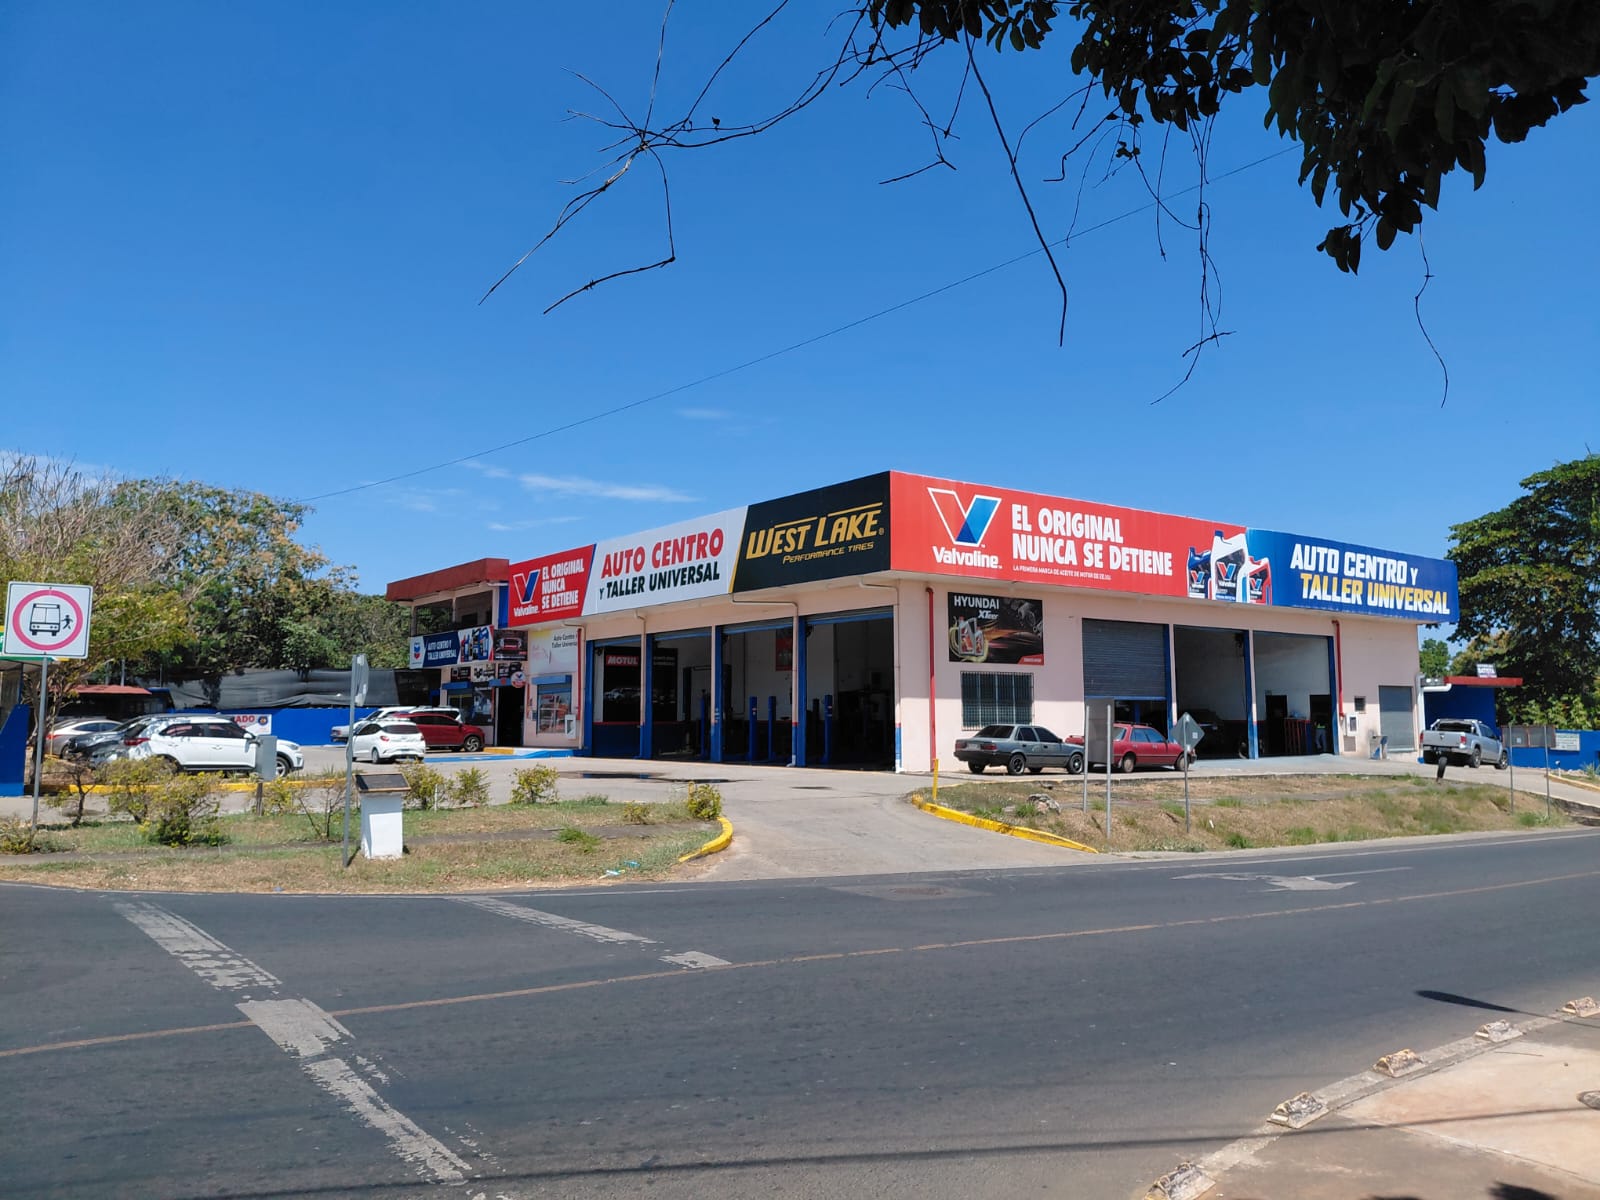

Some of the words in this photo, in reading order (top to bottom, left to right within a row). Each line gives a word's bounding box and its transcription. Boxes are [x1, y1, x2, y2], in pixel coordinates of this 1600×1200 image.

[746, 524, 811, 560] WEST
[814, 509, 881, 546] LAKE
[1011, 504, 1032, 531] EL
[1038, 508, 1124, 544] ORIGINAL
[601, 546, 646, 579] AUTO
[651, 528, 724, 568] CENTRO
[782, 546, 845, 565] PERFORMANCE
[847, 541, 874, 552] TIRES
[932, 546, 1000, 569] Valvoline
[1012, 533, 1078, 565] NUNCA
[1083, 543, 1104, 569] SE
[1109, 545, 1173, 576] DETIENE
[1290, 543, 1339, 572] AUTO
[1344, 551, 1408, 585] CENTRO
[1410, 568, 1419, 586] Y
[542, 566, 549, 580] EL
[551, 558, 584, 578] ORIGINAL
[599, 587, 605, 600] Y
[606, 573, 645, 599] TALLER
[649, 561, 720, 591] UNIVERSAL
[542, 578, 565, 595] NUNCA
[542, 595, 550, 609] SE
[551, 590, 579, 608] DETIENE
[954, 595, 1000, 609] HYUNDAI
[1300, 572, 1363, 605] TALLER
[1367, 583, 1450, 615] UNIVERSAL
[607, 655, 638, 665] MOTUL
